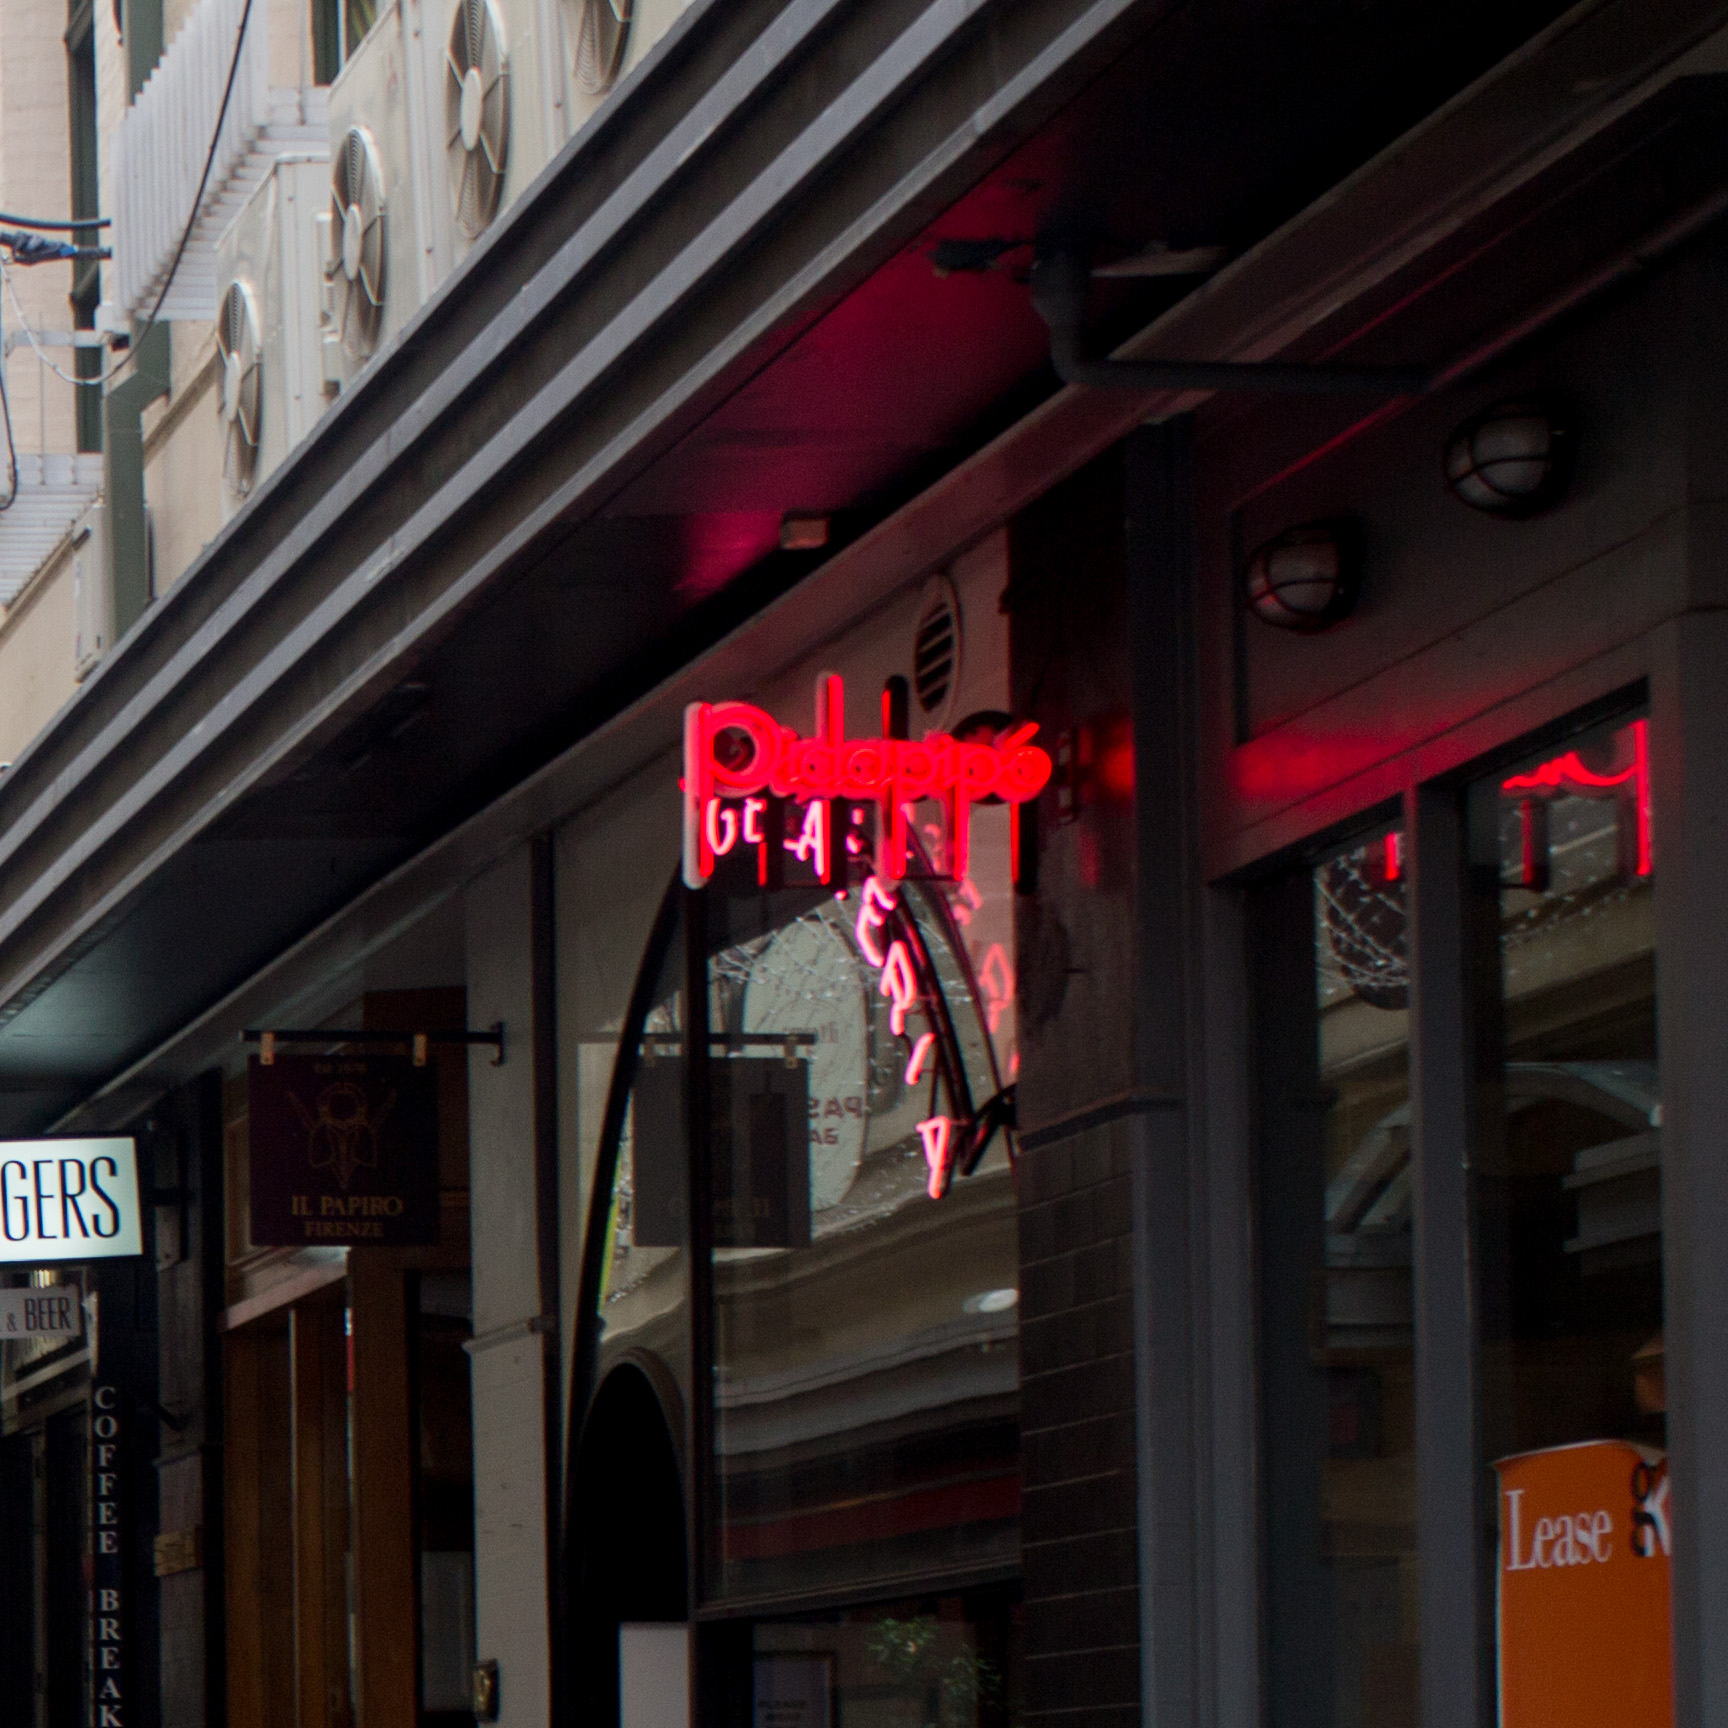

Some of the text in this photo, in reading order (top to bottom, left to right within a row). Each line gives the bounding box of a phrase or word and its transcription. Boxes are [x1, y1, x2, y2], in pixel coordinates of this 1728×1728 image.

[7, 1313, 18, 1332] &
[24, 1297, 71, 1331] BEER
[94, 1386, 119, 1553] COFFEE
[1504, 1488, 1614, 1571] Lease
